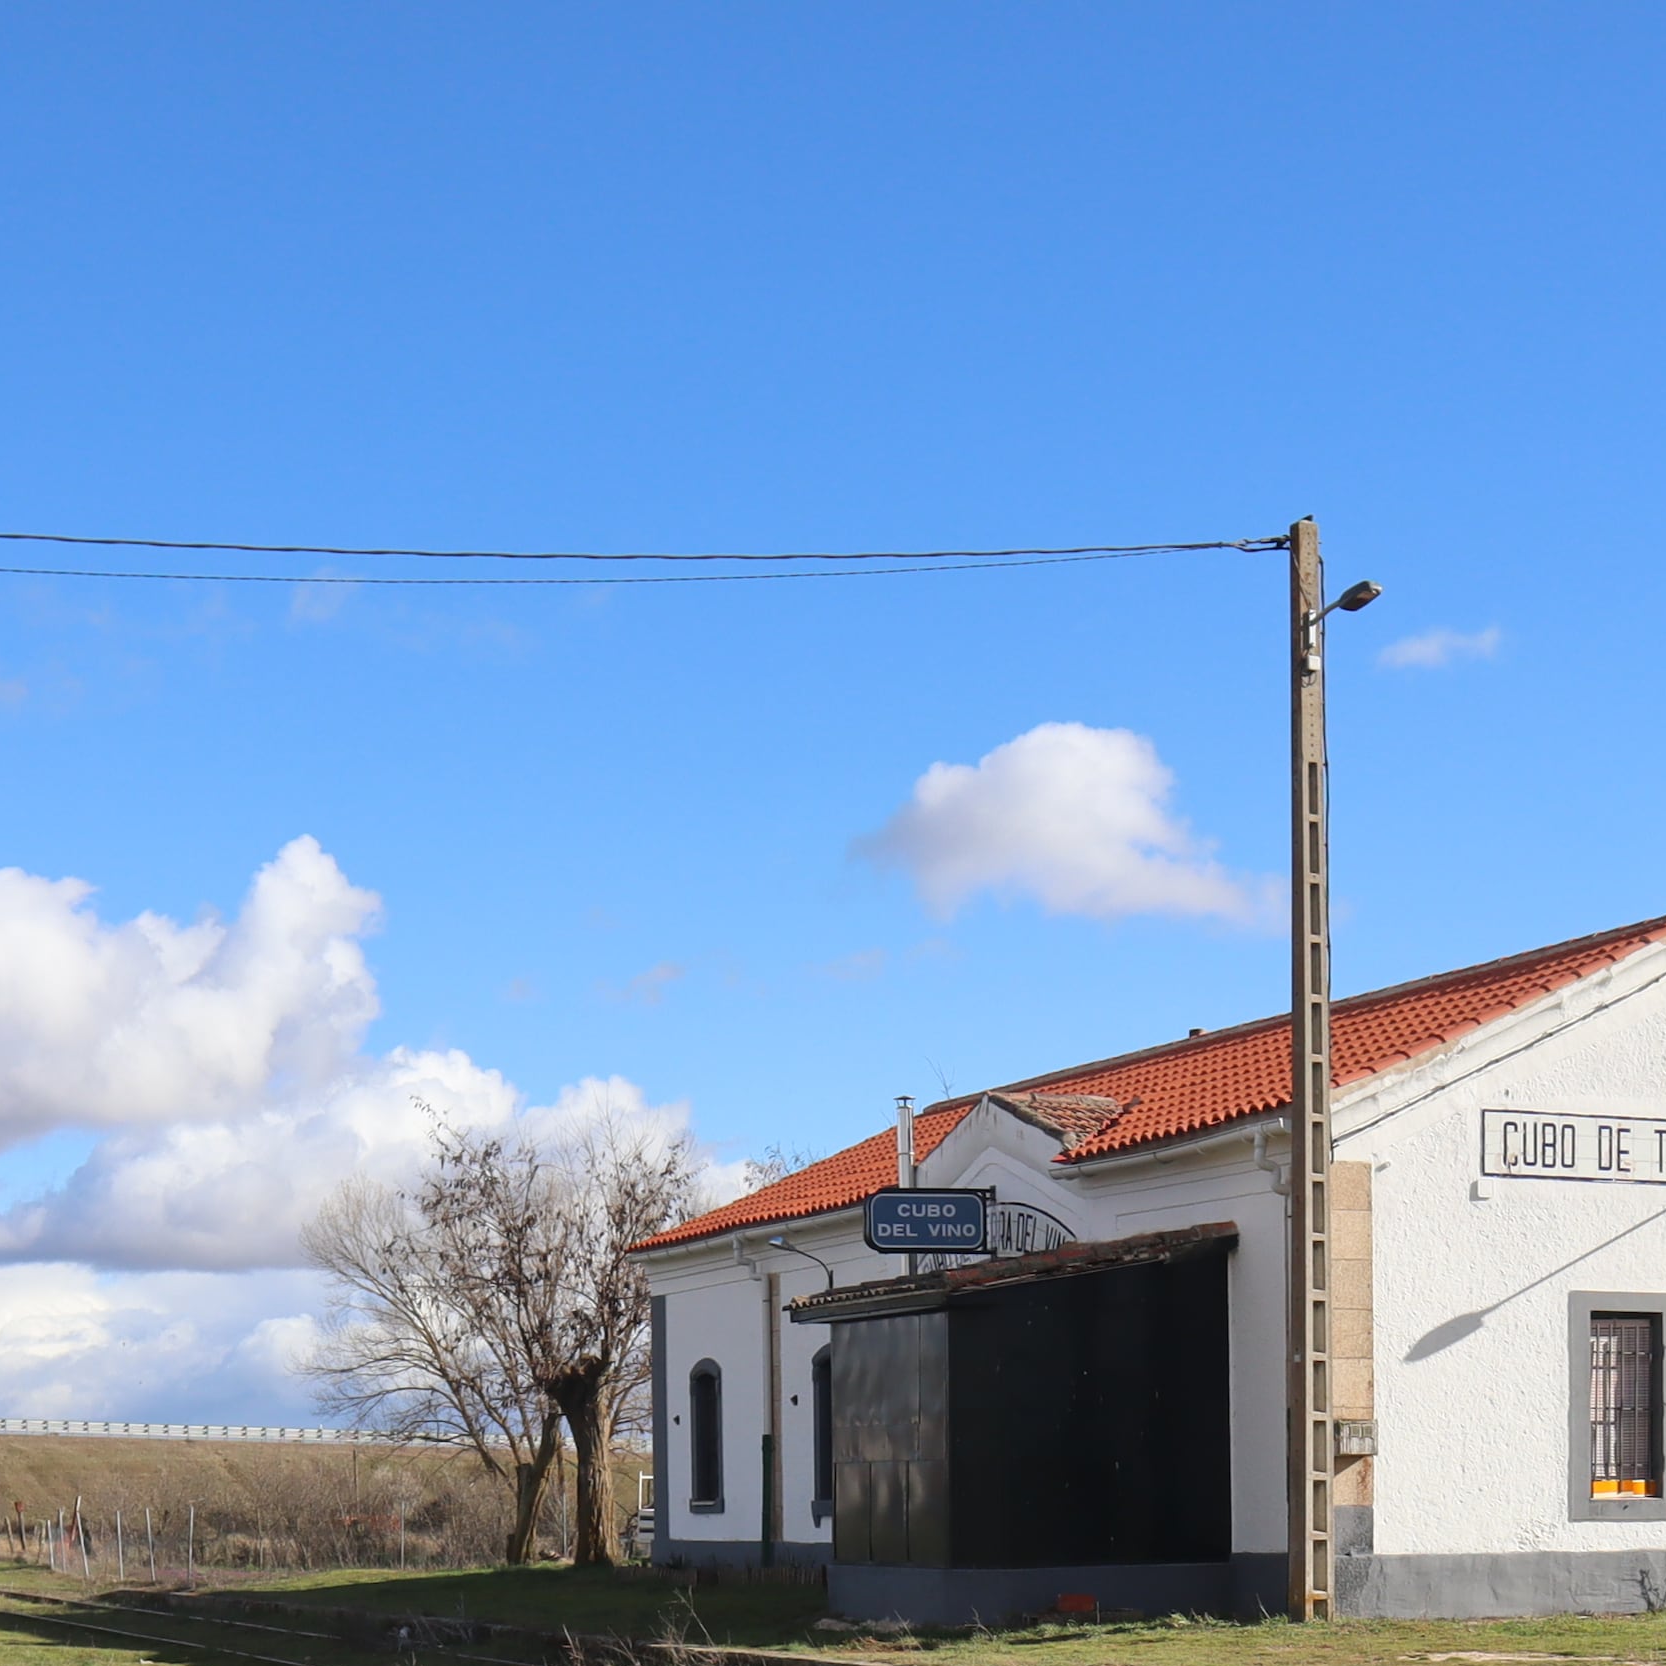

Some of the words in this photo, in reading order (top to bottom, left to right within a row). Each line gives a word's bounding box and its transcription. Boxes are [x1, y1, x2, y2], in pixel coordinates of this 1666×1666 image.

[1503, 1121, 1575, 1168] CUBO
[1598, 1125, 1631, 1173] DE
[897, 1204, 957, 1218] CUBO
[877, 1223, 918, 1237] DEL
[927, 1223, 976, 1237] VINO
